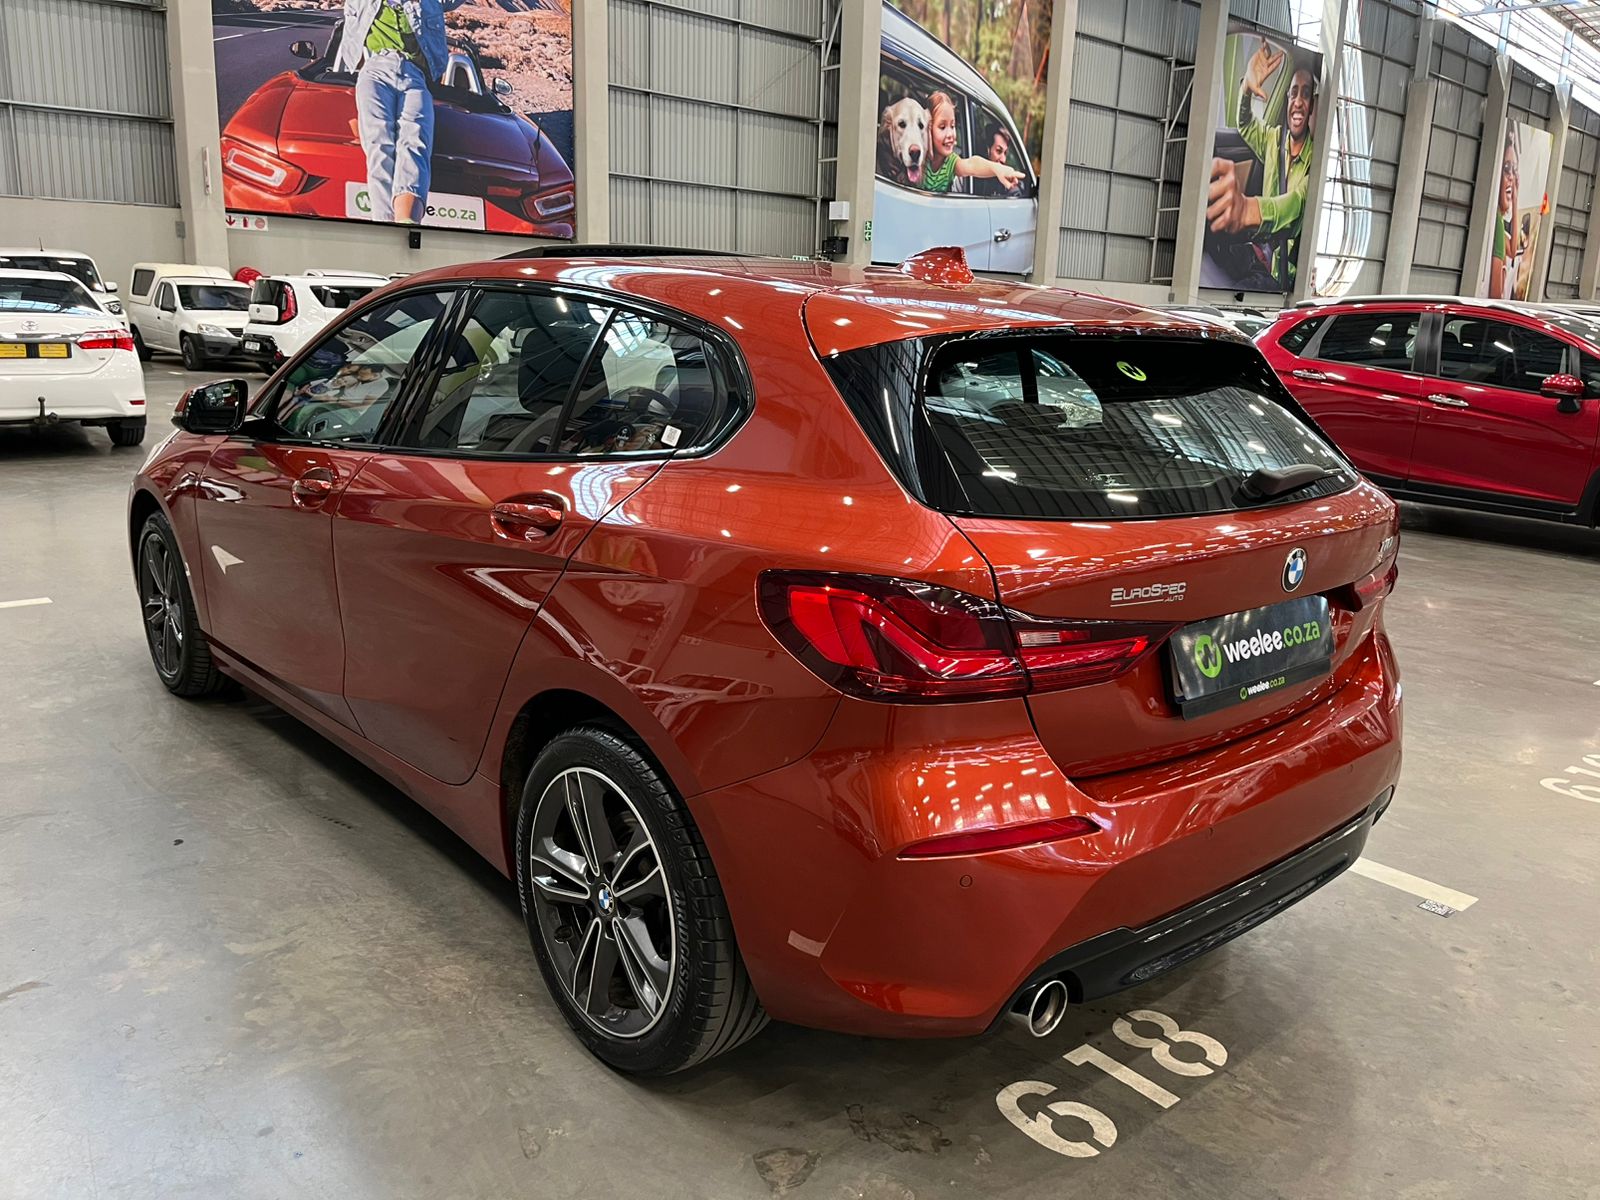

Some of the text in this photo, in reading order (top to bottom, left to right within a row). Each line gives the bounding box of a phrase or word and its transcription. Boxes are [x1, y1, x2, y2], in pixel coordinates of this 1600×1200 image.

[1164, 594, 1185, 602] AUTO
[1223, 620, 1321, 663] weelee.co.za
[995, 1009, 1229, 1158] 618
